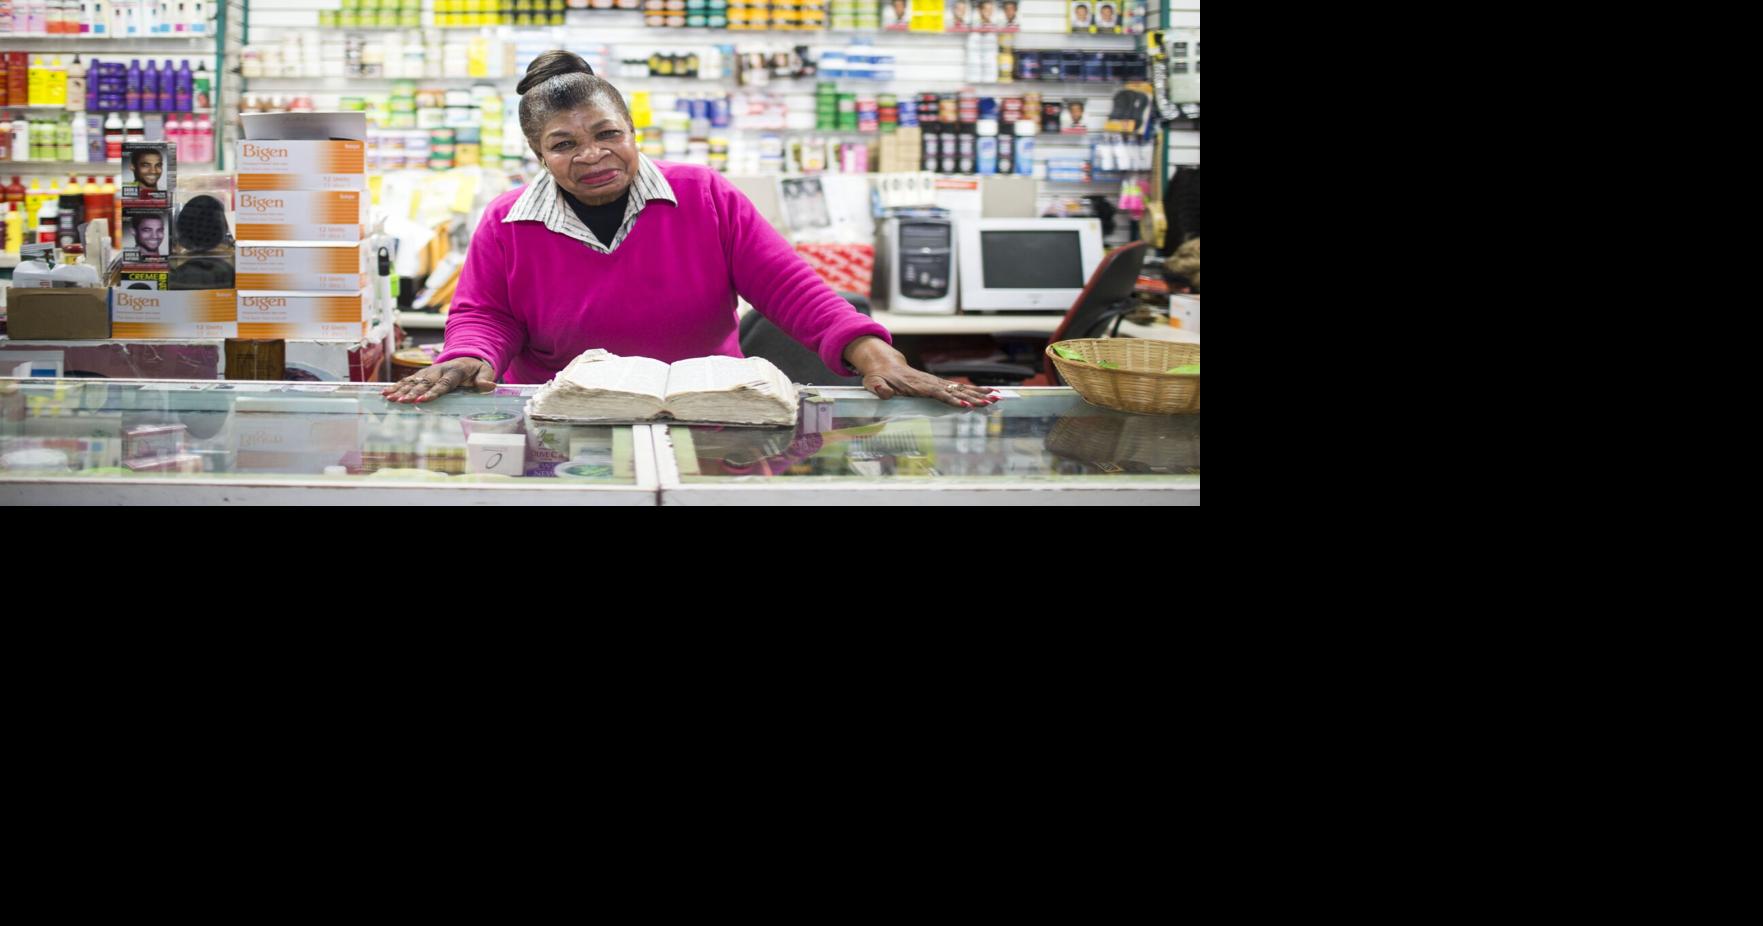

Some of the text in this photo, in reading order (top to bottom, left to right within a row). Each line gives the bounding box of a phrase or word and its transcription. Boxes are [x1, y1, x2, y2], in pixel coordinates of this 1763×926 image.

[242, 143, 288, 161] Bigen
[240, 194, 284, 212] Bigen
[240, 247, 284, 262] Bigen
[128, 273, 159, 281] CREME
[117, 293, 160, 311] Bigen
[242, 296, 287, 311] Bigen
